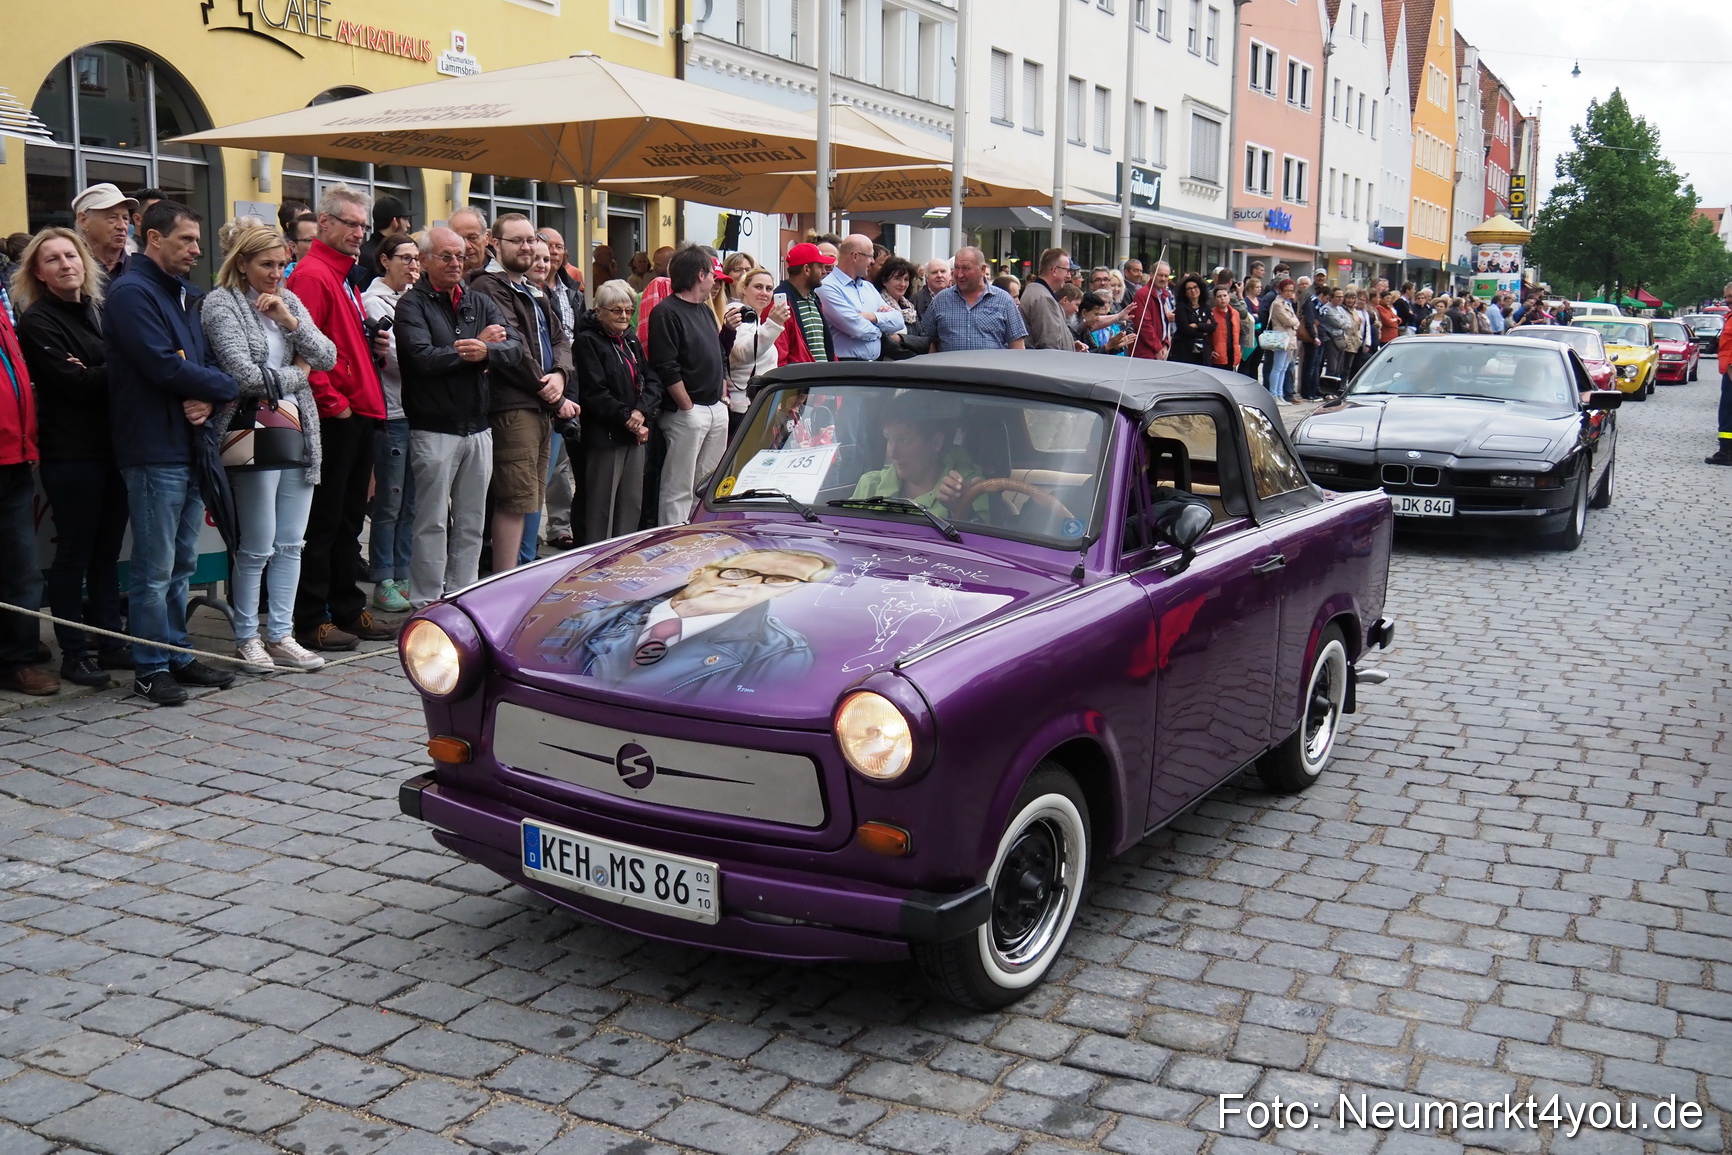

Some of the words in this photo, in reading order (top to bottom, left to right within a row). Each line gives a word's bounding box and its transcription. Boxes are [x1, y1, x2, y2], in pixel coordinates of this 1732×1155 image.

[337, 19, 365, 48] AM
[366, 25, 432, 62] RATHAUS
[446, 53, 475, 66] Neumarkter
[441, 60, 480, 76] Lammsbräu
[662, 214, 672, 227] 24
[787, 455, 816, 469] 135
[1401, 498, 1421, 512] DK
[1424, 499, 1451, 514] 840
[529, 851, 536, 863] D
[541, 834, 592, 881] KEH
[609, 852, 646, 894] MS
[654, 863, 690, 905] 86
[695, 871, 710, 884] 03
[697, 897, 711, 909] 10
